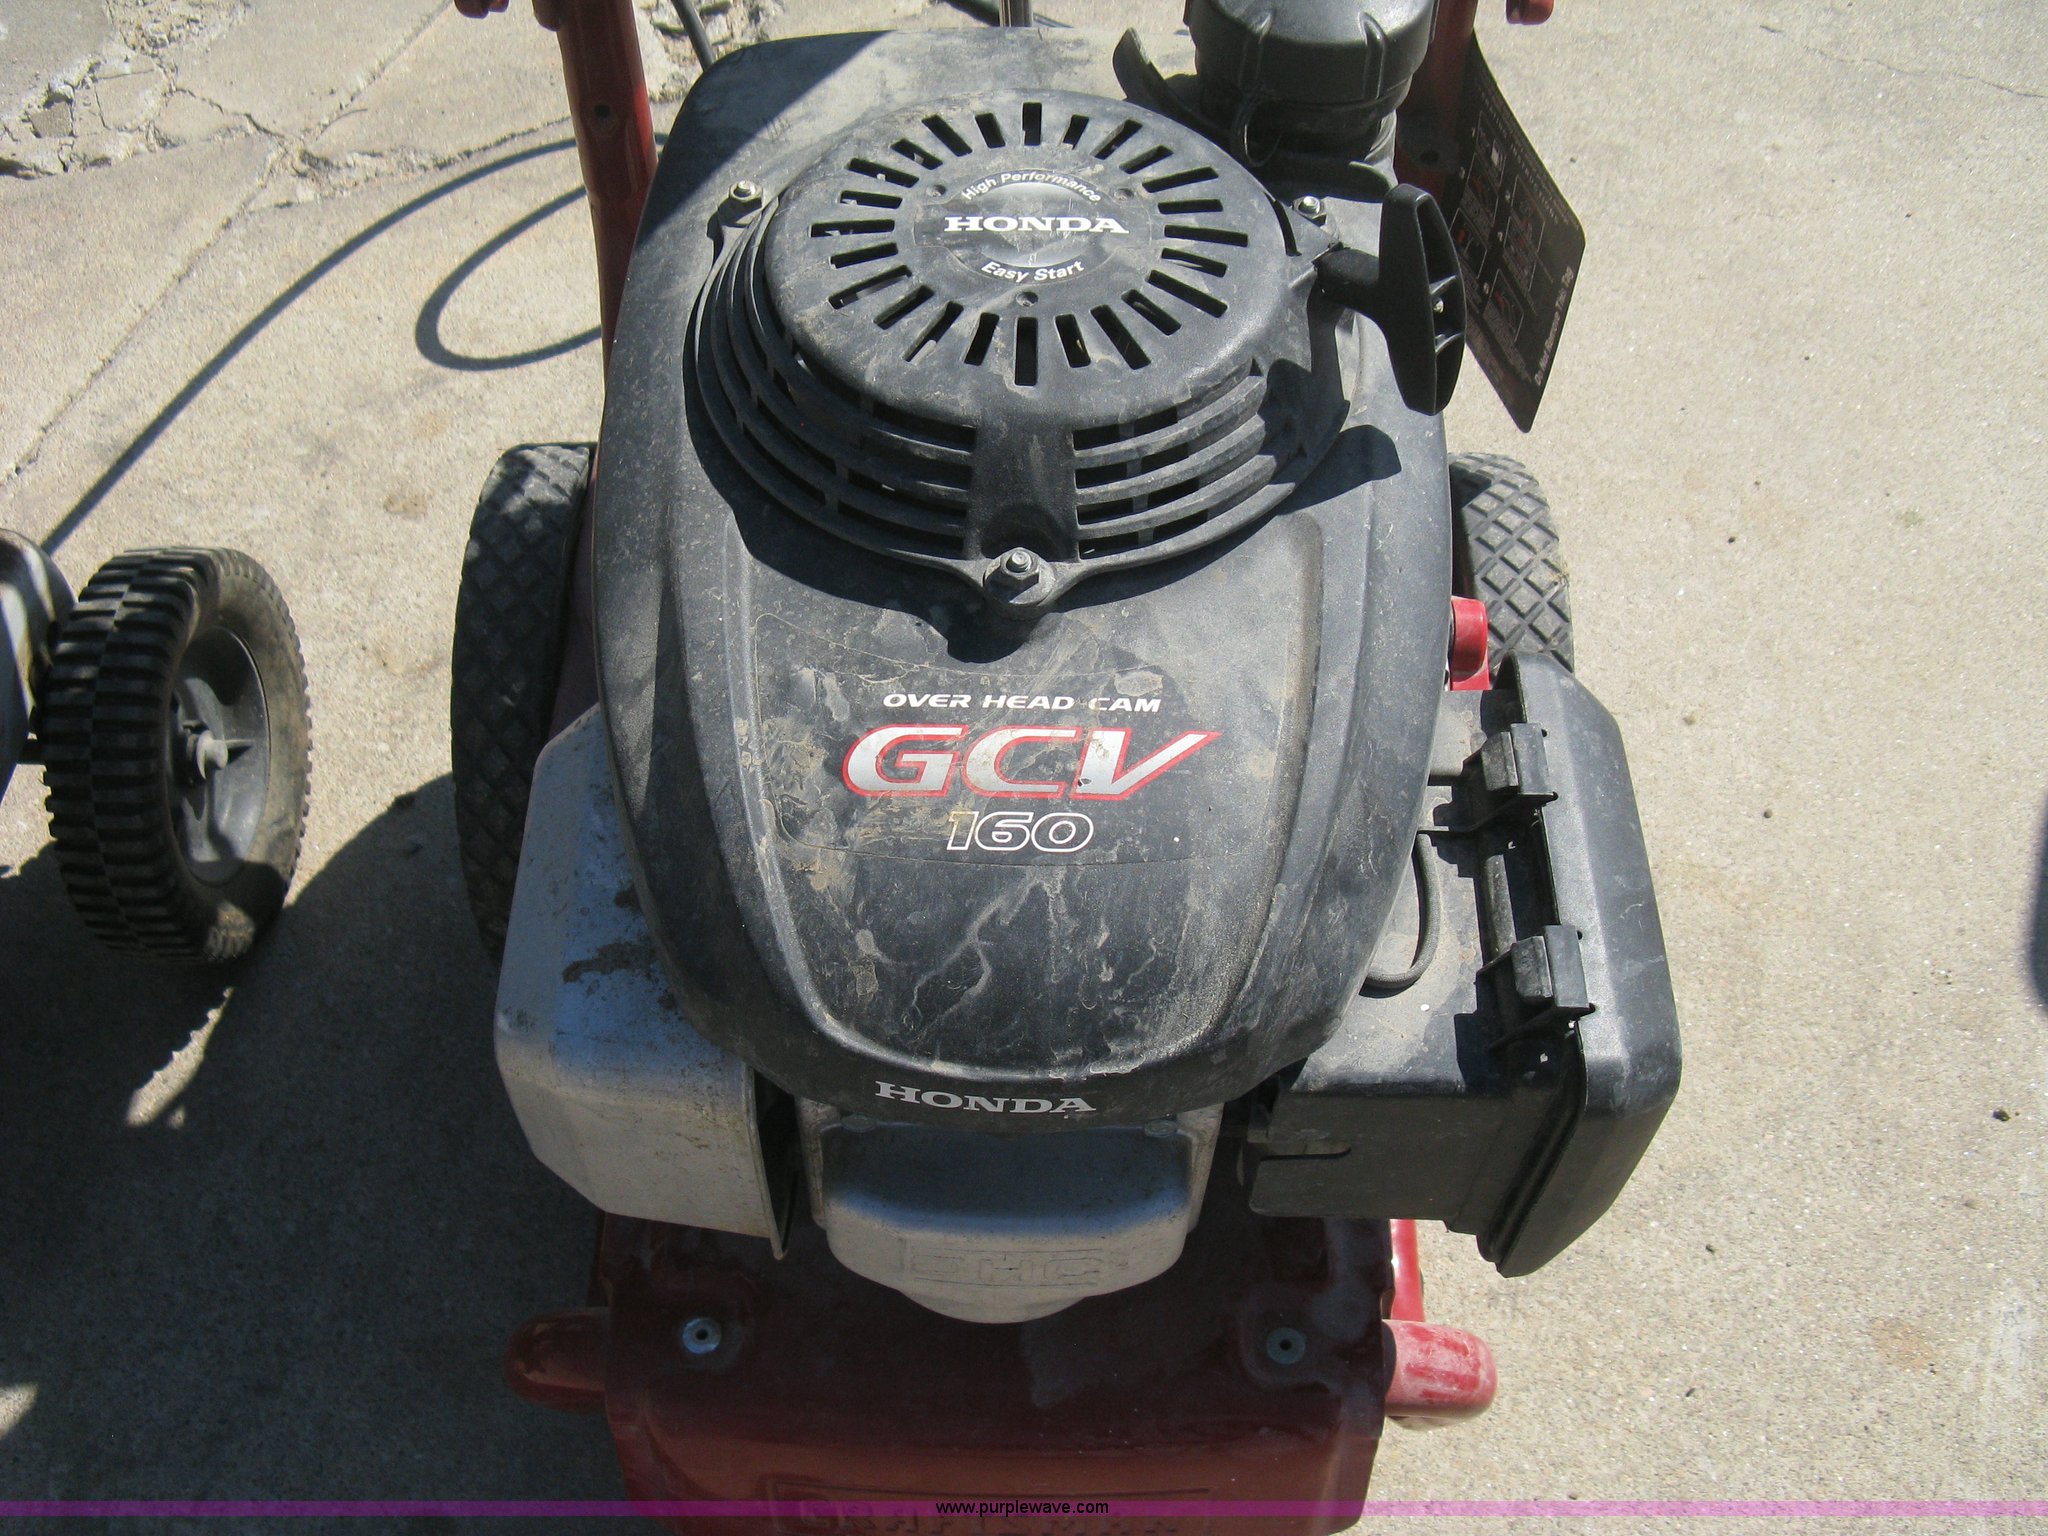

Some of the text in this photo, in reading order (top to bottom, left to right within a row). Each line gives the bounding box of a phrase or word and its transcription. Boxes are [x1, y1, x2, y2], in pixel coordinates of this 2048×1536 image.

[961, 171, 1101, 203] High Performance
[944, 216, 1129, 234] HONDA
[981, 260, 1085, 283] Easy Start
[883, 693, 1161, 713] OVER HEAD CAM
[841, 723, 1222, 801] GCV
[946, 811, 1094, 852] 160
[874, 1080, 1096, 1114] HONDA
